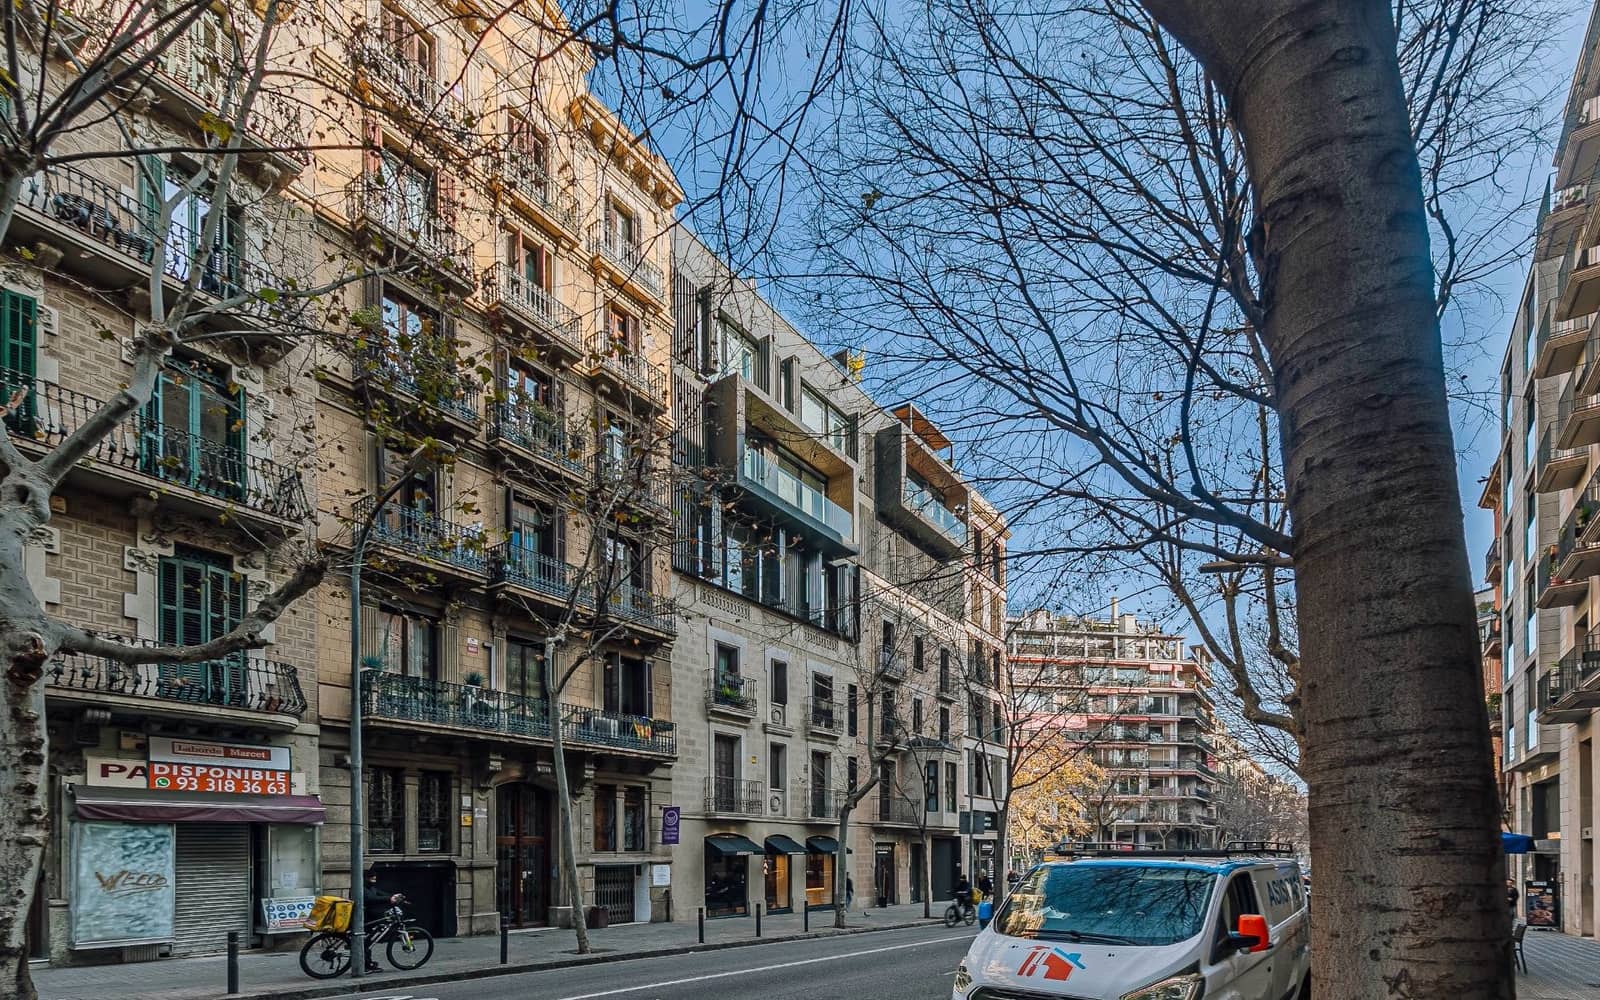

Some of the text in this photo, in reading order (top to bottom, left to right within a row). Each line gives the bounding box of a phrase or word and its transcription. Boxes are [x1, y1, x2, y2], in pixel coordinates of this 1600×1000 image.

[230, 748, 266, 759] Marcet
[154, 763, 286, 782] DISPONIBLE
[176, 776, 286, 794] 93 318 36 63
